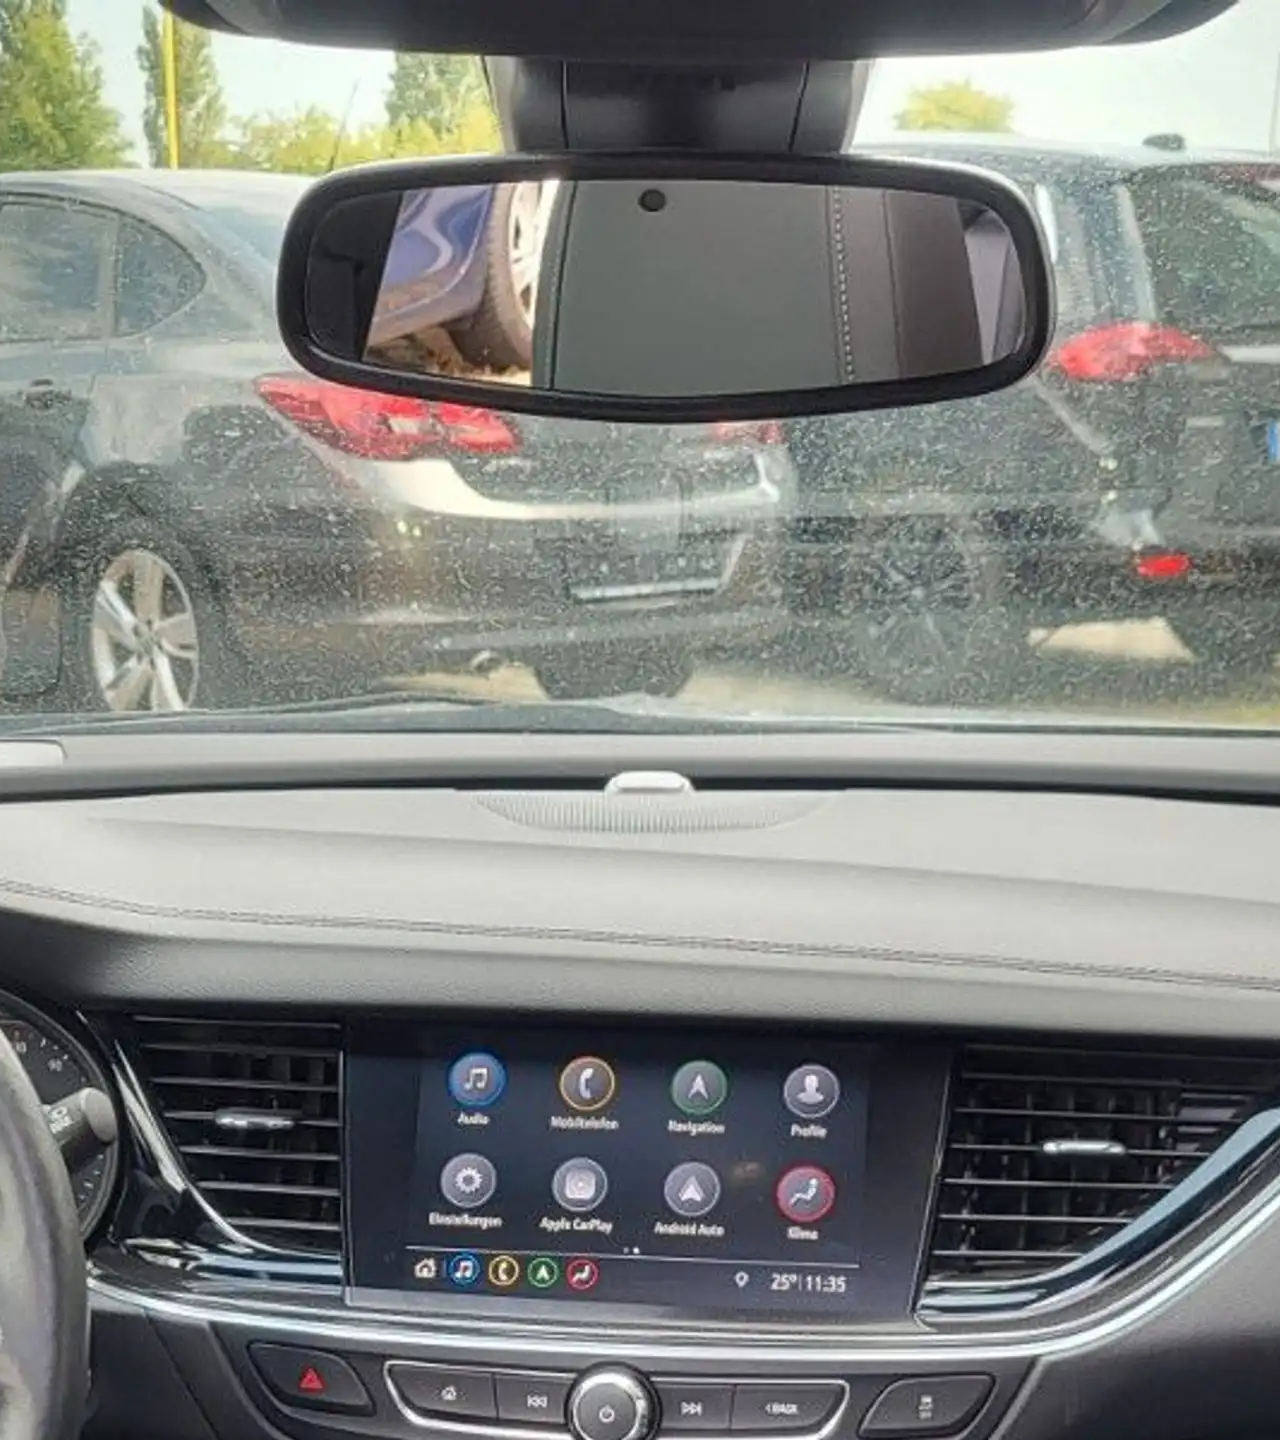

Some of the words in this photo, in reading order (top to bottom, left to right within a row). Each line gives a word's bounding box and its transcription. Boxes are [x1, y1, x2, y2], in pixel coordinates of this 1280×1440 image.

[457, 1112, 491, 1126] Audio
[667, 1120, 726, 1136] Navigation
[790, 1124, 828, 1138] Profile
[539, 1217, 571, 1232] Apple
[573, 1218, 613, 1235] CarPlay
[654, 1222, 696, 1235] Android
[698, 1224, 725, 1237] Auto
[805, 1276, 847, 1292] 11:35
